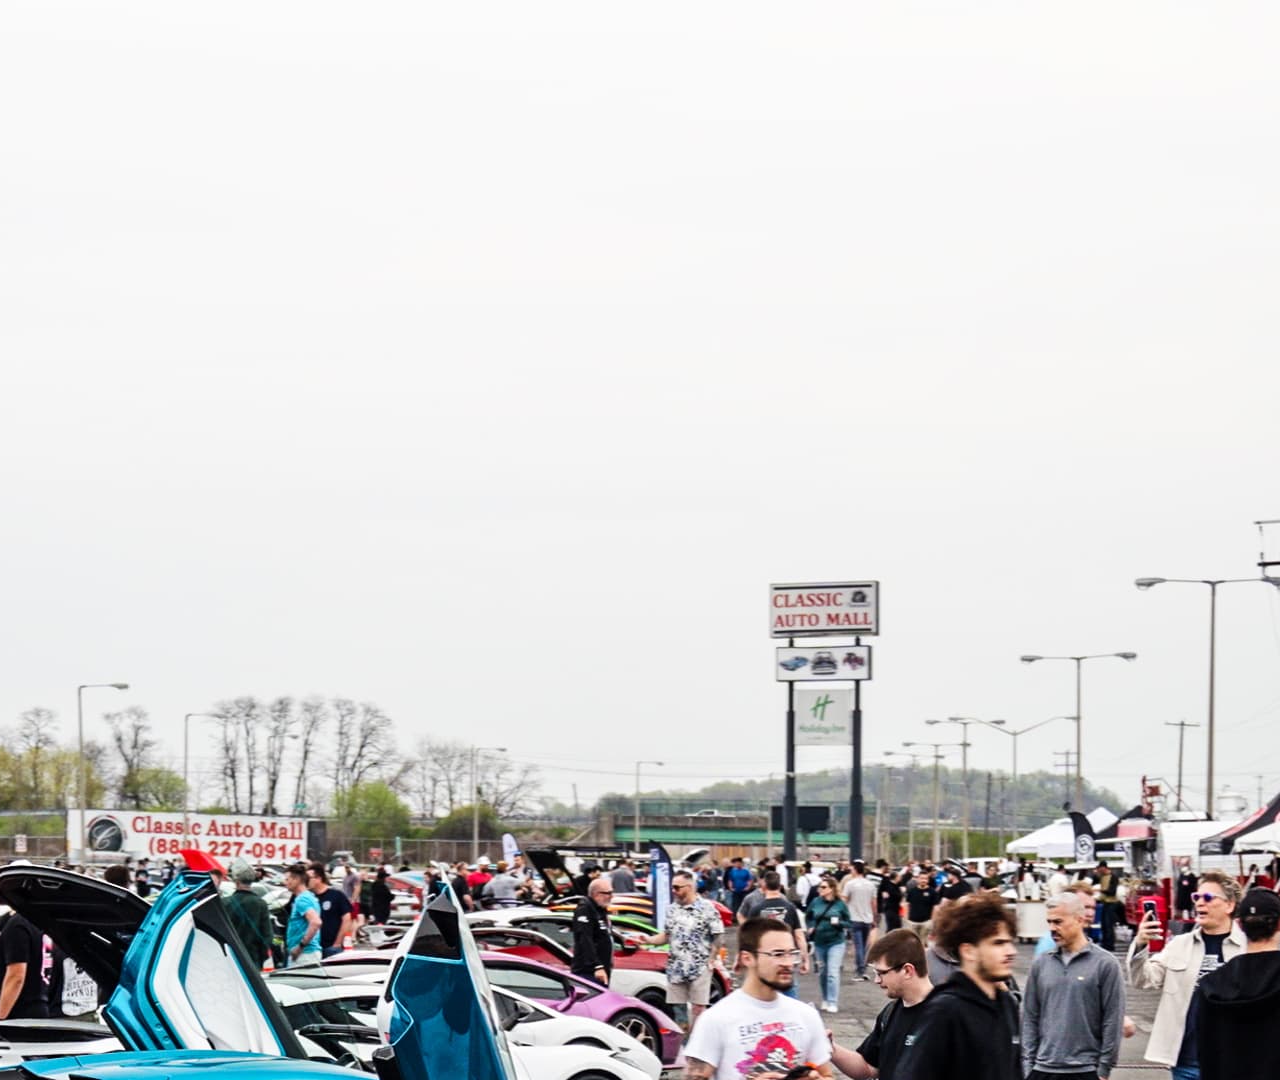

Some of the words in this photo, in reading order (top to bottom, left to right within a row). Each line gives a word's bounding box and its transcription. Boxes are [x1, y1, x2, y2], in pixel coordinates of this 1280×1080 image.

[773, 592, 843, 608] CLASSIC
[774, 613, 820, 628] AUTO
[826, 612, 872, 626] MALL
[132, 815, 201, 835] Classic
[205, 819, 254, 838] Auto
[258, 820, 304, 840] Mall
[208, 840, 302, 860] 227-0914
